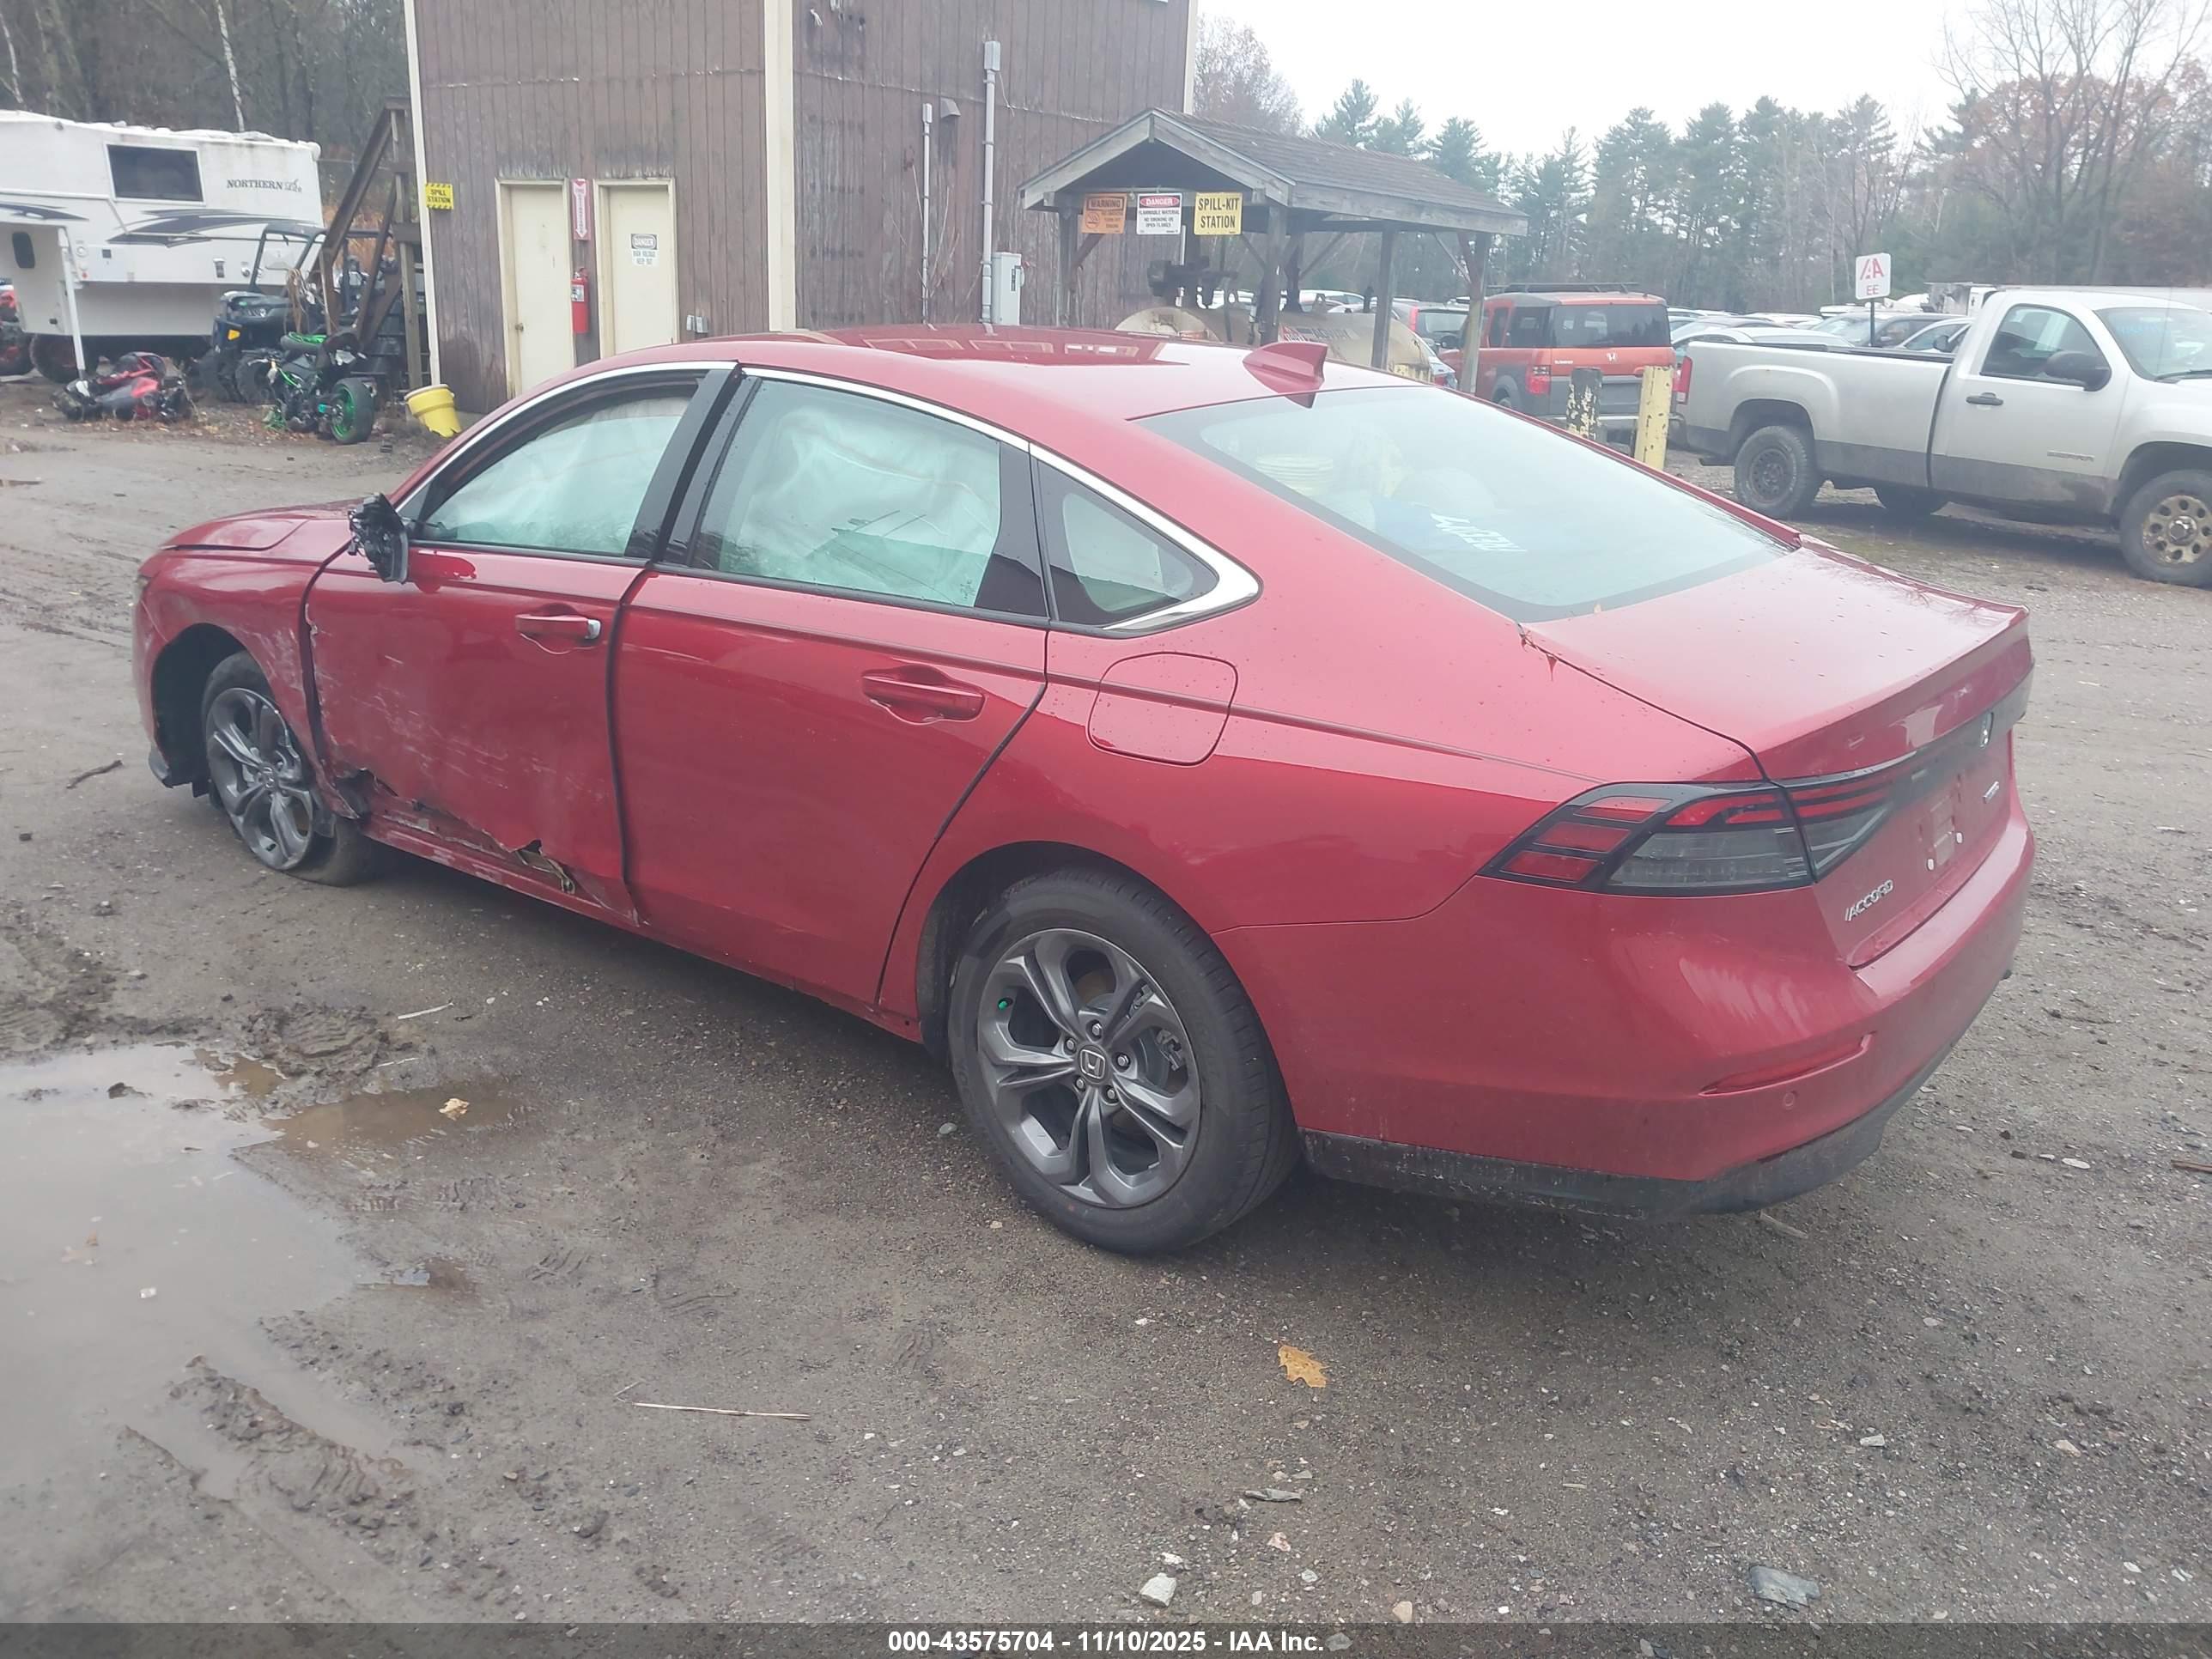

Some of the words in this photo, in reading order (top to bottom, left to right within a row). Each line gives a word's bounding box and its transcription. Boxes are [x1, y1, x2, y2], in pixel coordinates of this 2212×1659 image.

[226, 179, 283, 190] NORTHERN
[1091, 198, 1121, 207] WARNING
[1146, 198, 1173, 206] DANGER
[1198, 198, 1239, 210] SPILL-KIT
[1200, 216, 1236, 228] STATION
[1867, 284, 1879, 295] EE
[1844, 879, 1893, 921] ACCORD
